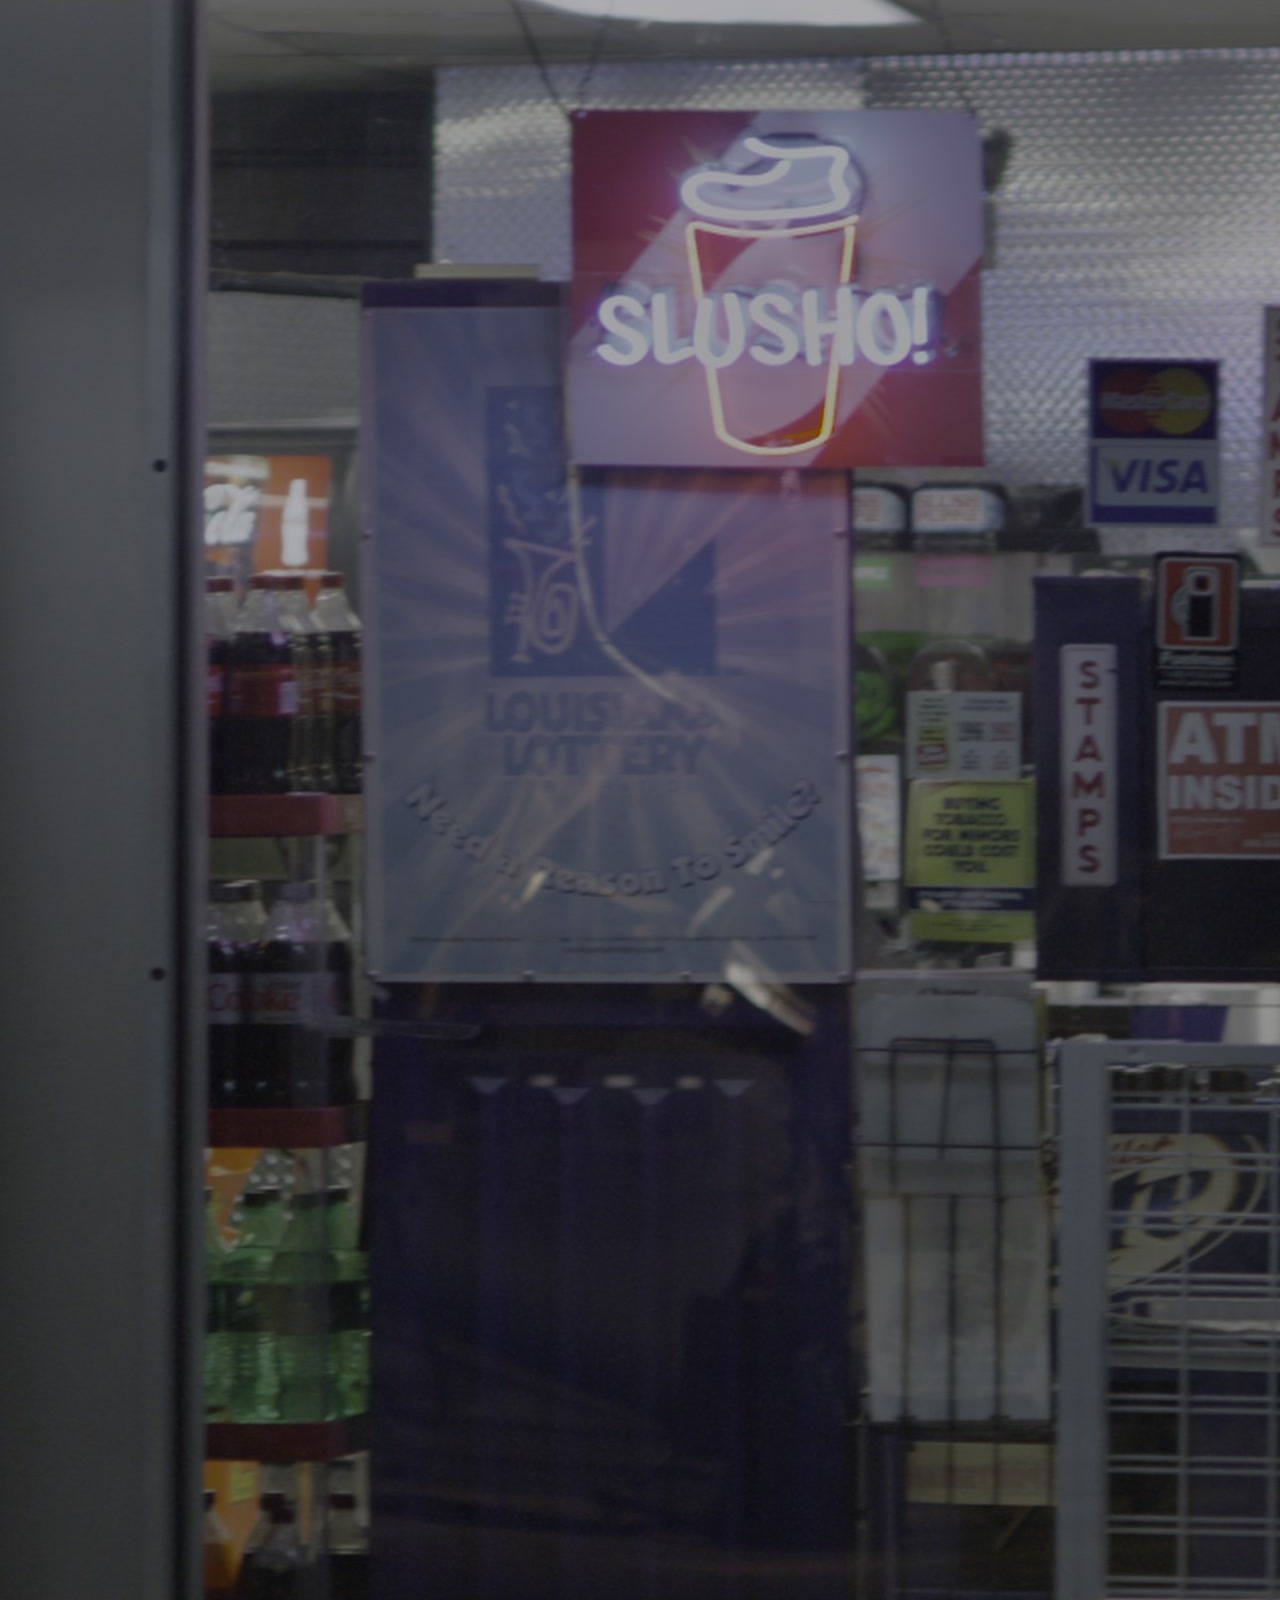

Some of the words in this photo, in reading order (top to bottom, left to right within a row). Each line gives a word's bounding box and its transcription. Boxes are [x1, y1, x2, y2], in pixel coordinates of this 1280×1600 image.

[596, 287, 930, 368] SLUSHO!
[1103, 457, 1209, 494] VISA
[483, 688, 718, 733] LOUISI
[1073, 660, 1106, 874] STAMPS
[404, 777, 499, 863] Need
[670, 851, 724, 889] To
